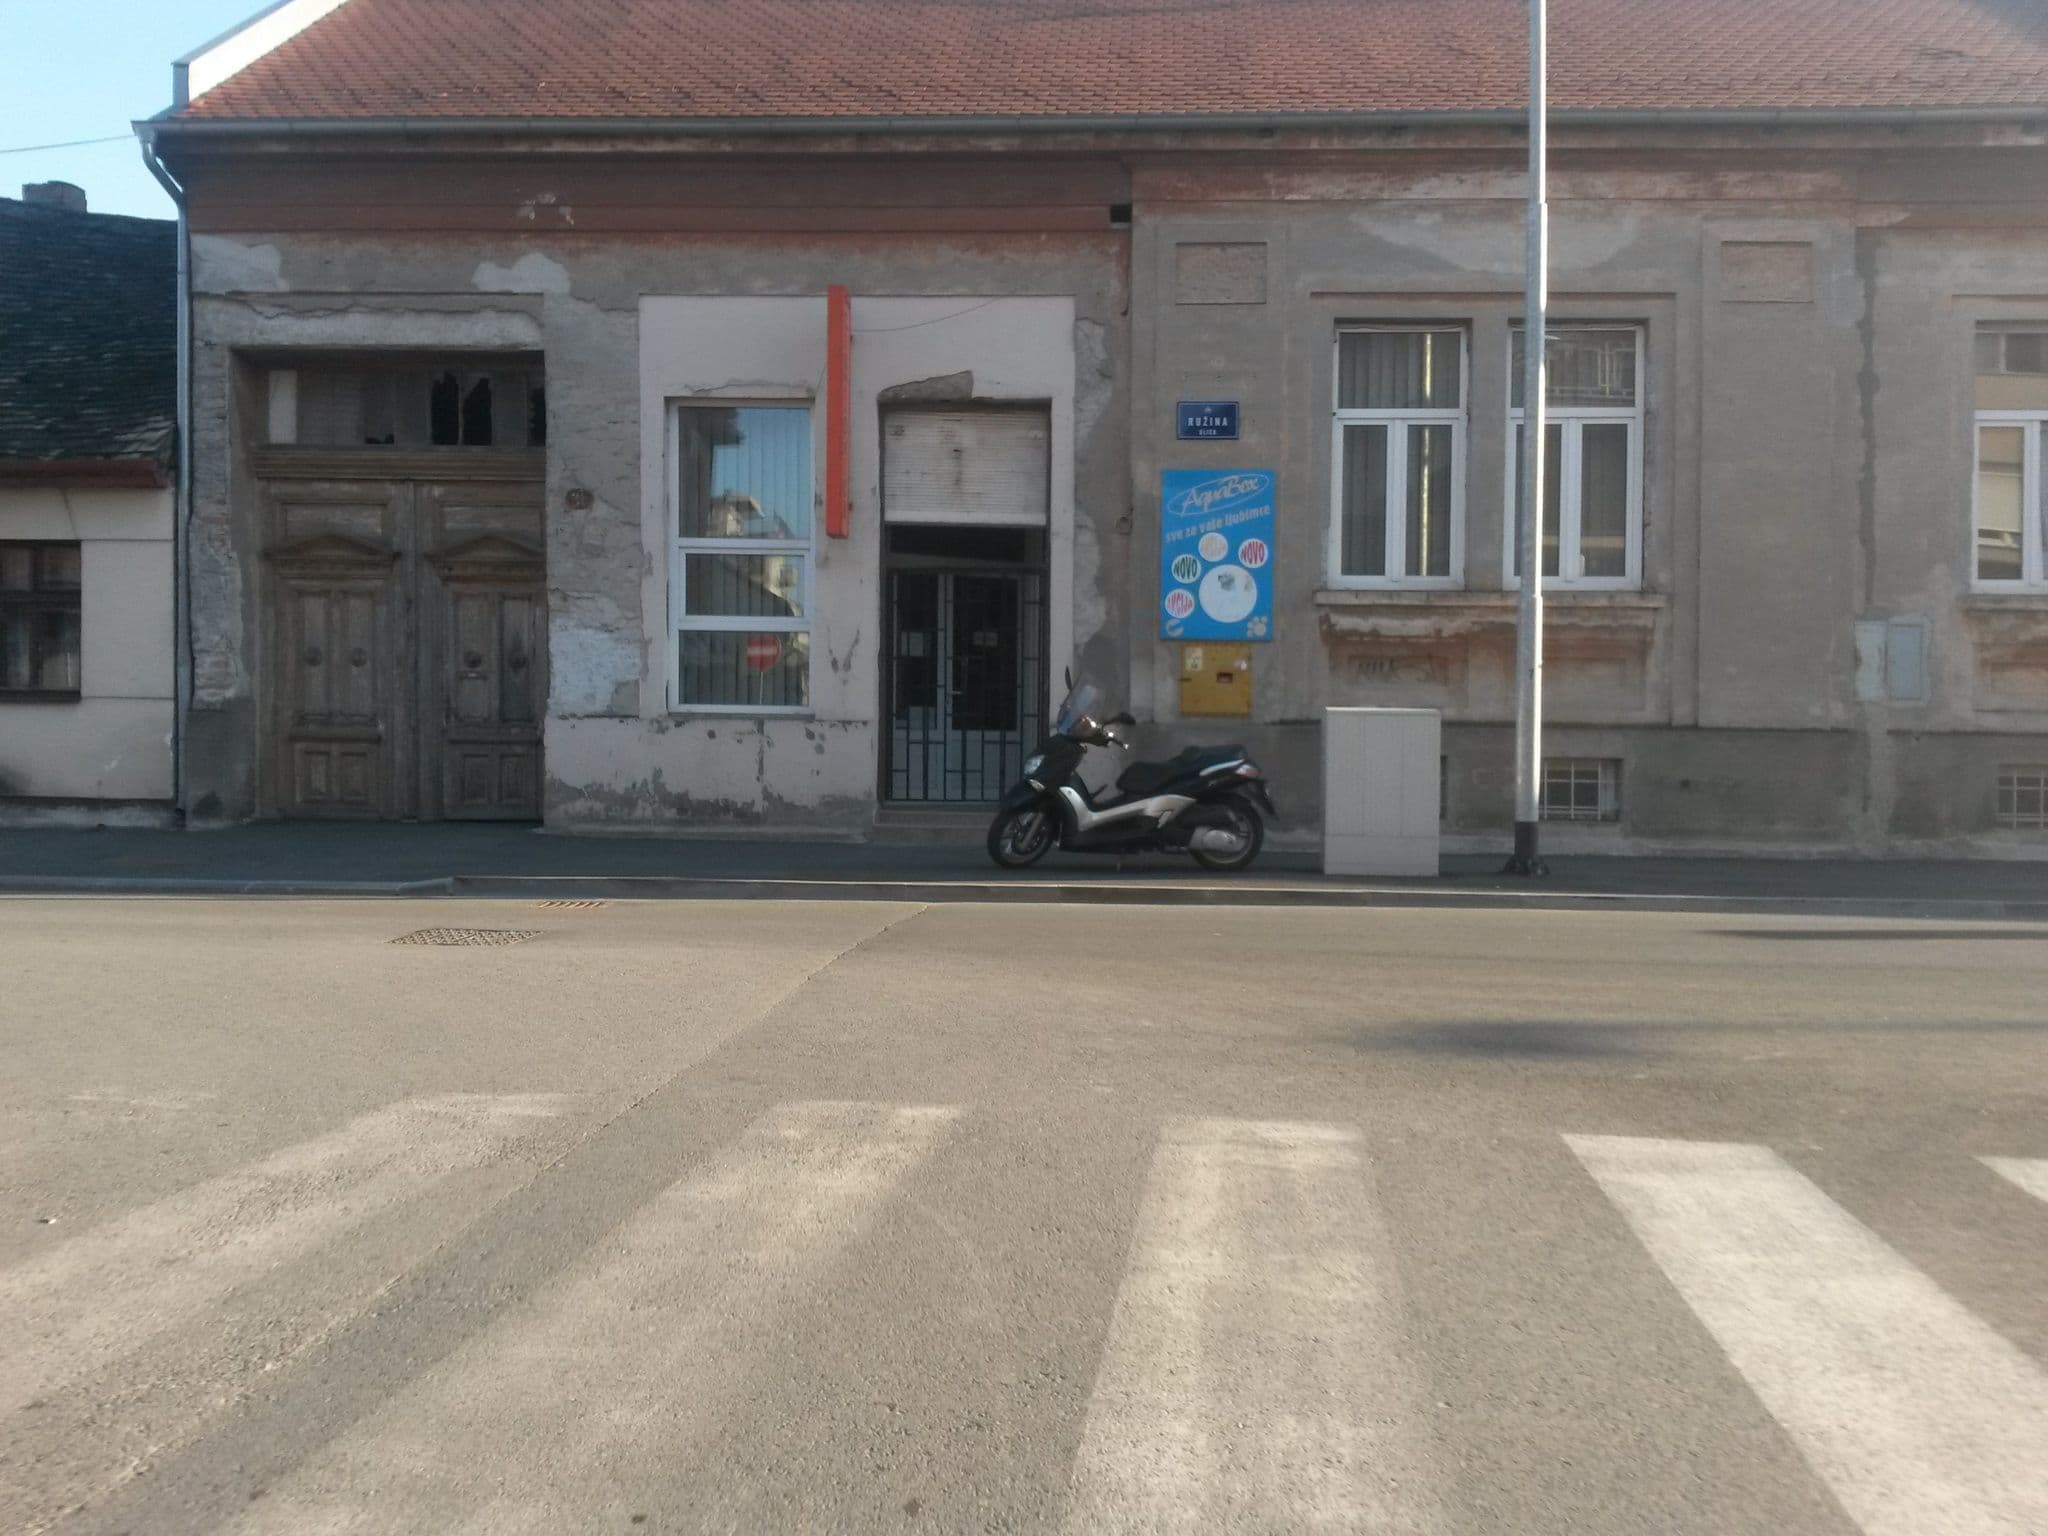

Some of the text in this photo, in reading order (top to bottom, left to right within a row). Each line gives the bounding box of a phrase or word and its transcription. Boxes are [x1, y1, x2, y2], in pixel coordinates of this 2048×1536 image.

[1187, 416, 1228, 427] RUŽINA
[1182, 475, 1259, 513] AquaBox
[1166, 530, 1183, 543] sve
[1184, 525, 1197, 538] za
[1241, 540, 1266, 565] NOVO
[1173, 555, 1198, 580] NOVO
